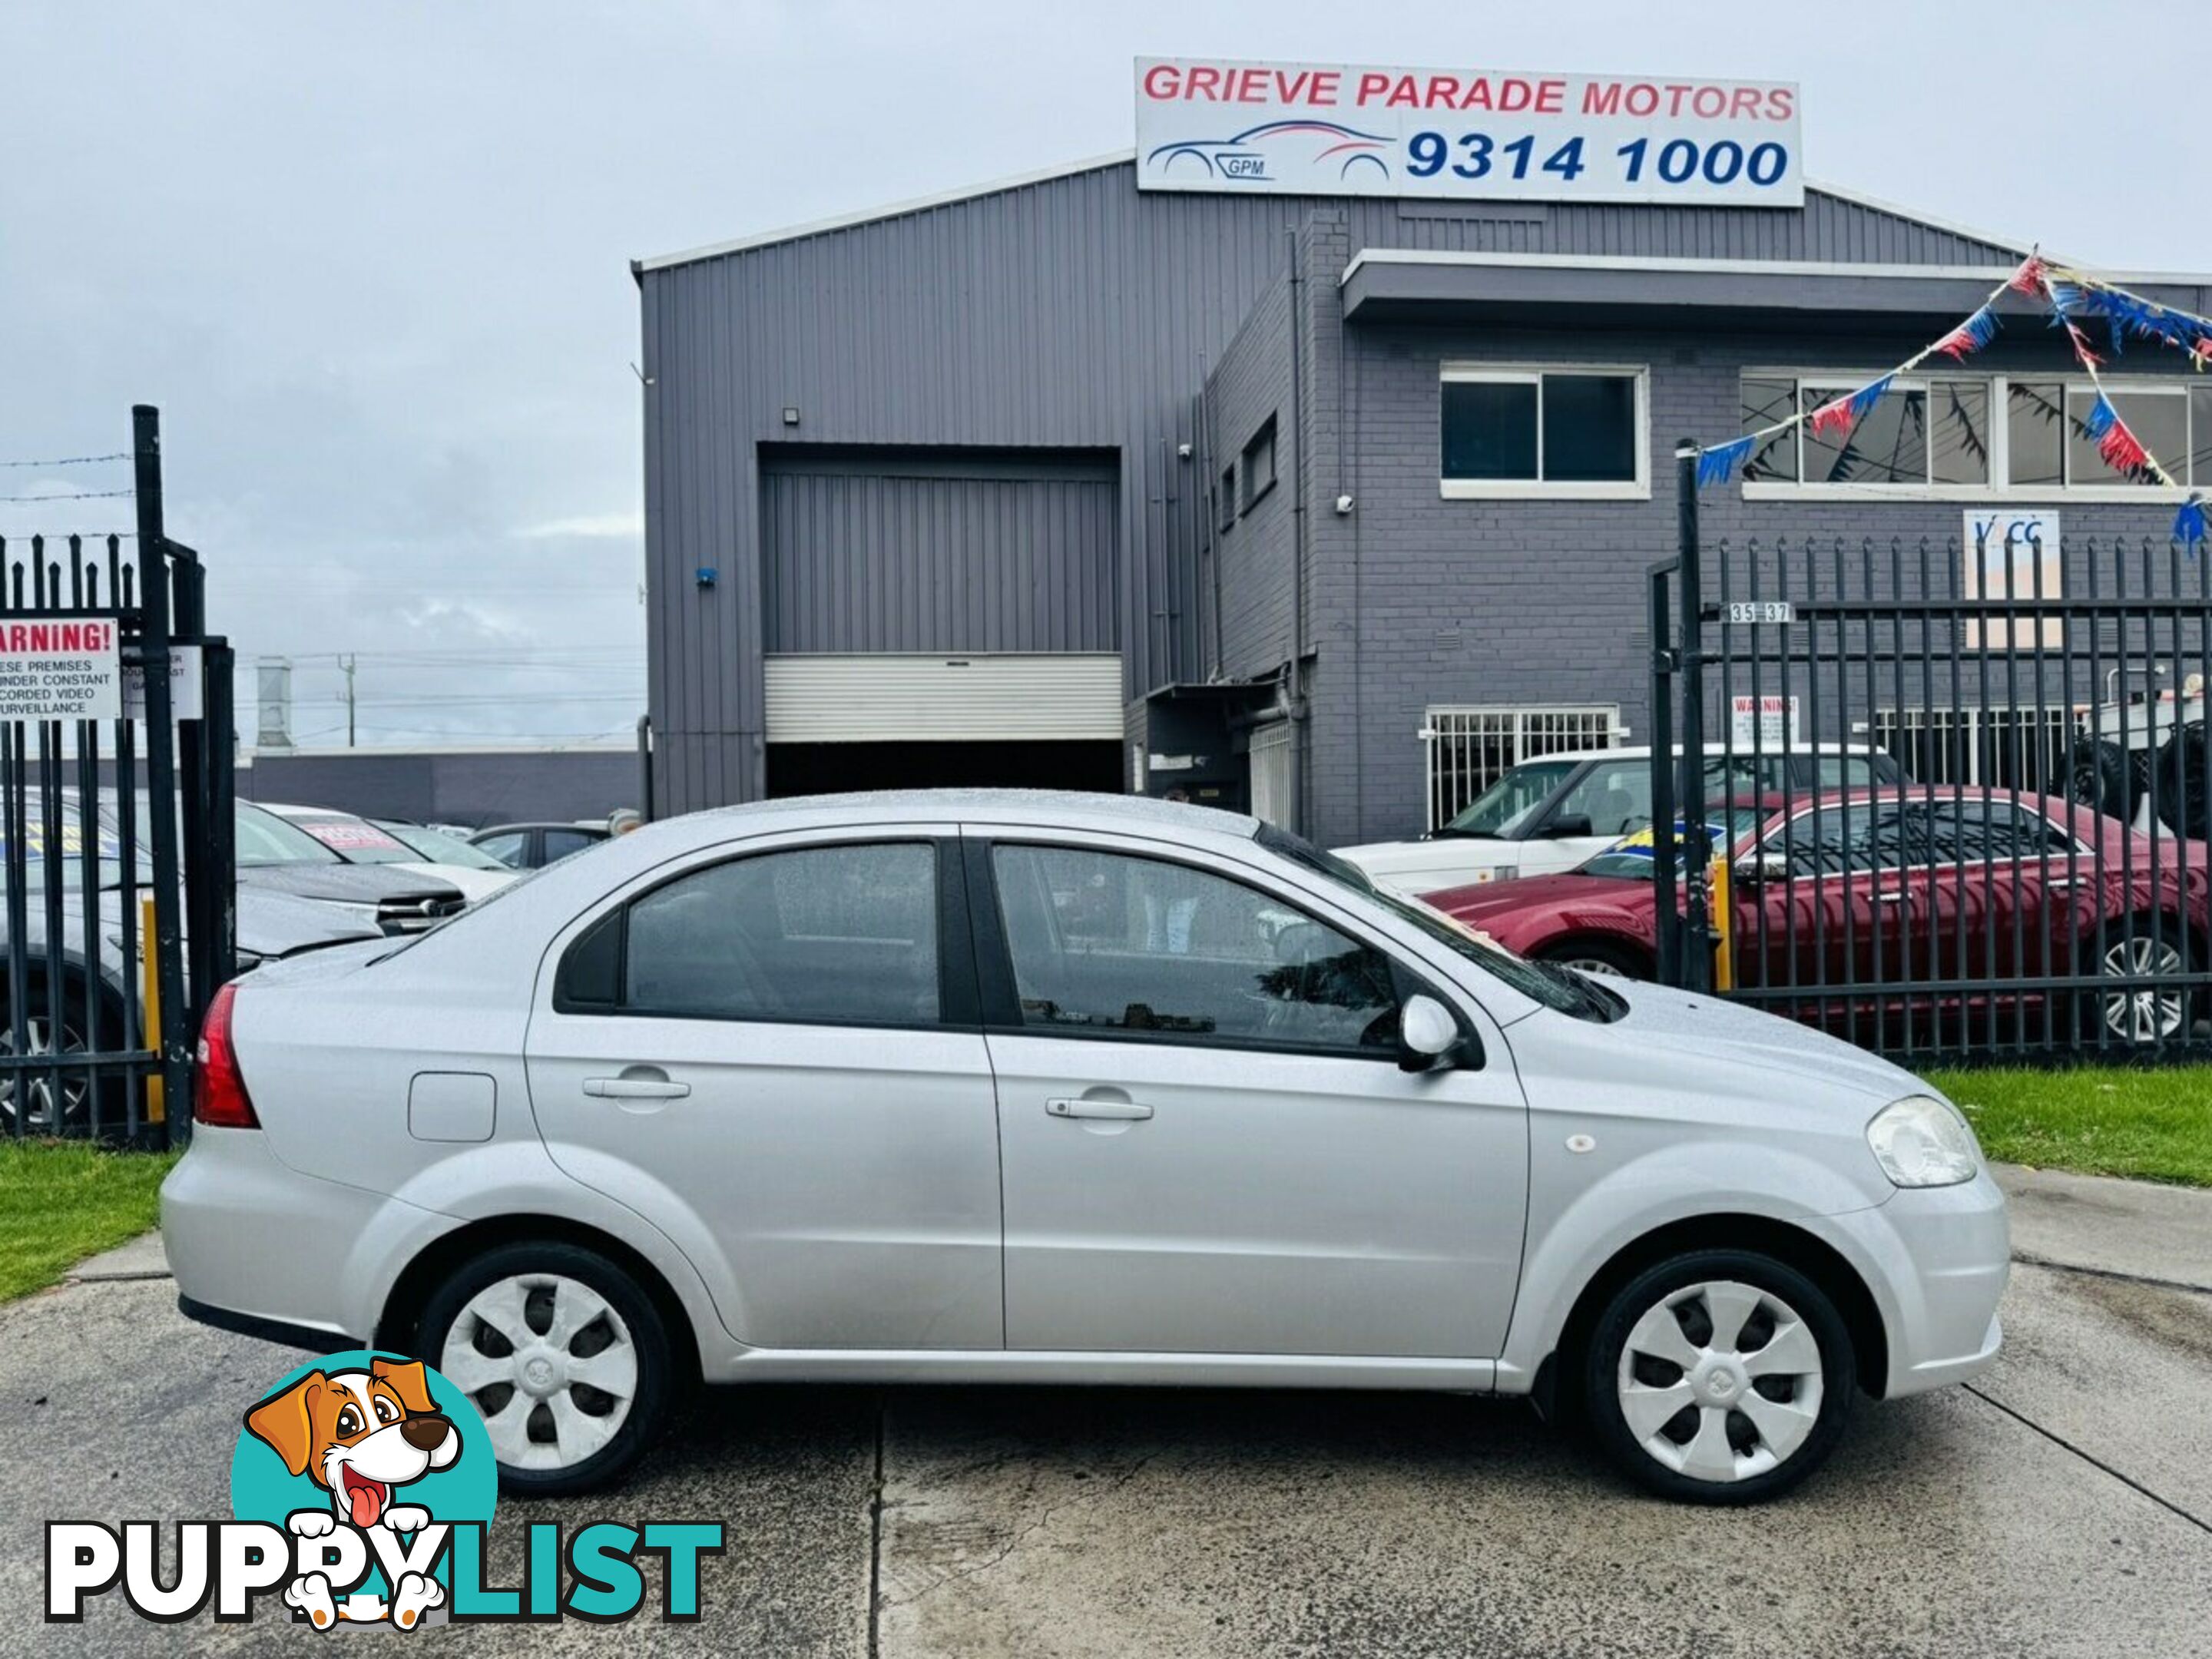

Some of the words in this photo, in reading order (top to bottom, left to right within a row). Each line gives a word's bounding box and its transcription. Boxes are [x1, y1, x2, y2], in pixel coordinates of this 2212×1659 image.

[1144, 65, 1341, 105] GRIEVE
[1356, 73, 1566, 113] PARADE
[1581, 81, 1793, 121] MOTORS
[1406, 131, 1584, 180] 9314
[1618, 137, 1788, 186] 1000
[1229, 160, 1265, 175] GPM
[28, 661, 92, 671] PREMISES
[43, 674, 111, 686] CONSTANT
[57, 688, 94, 699] VIDEO
